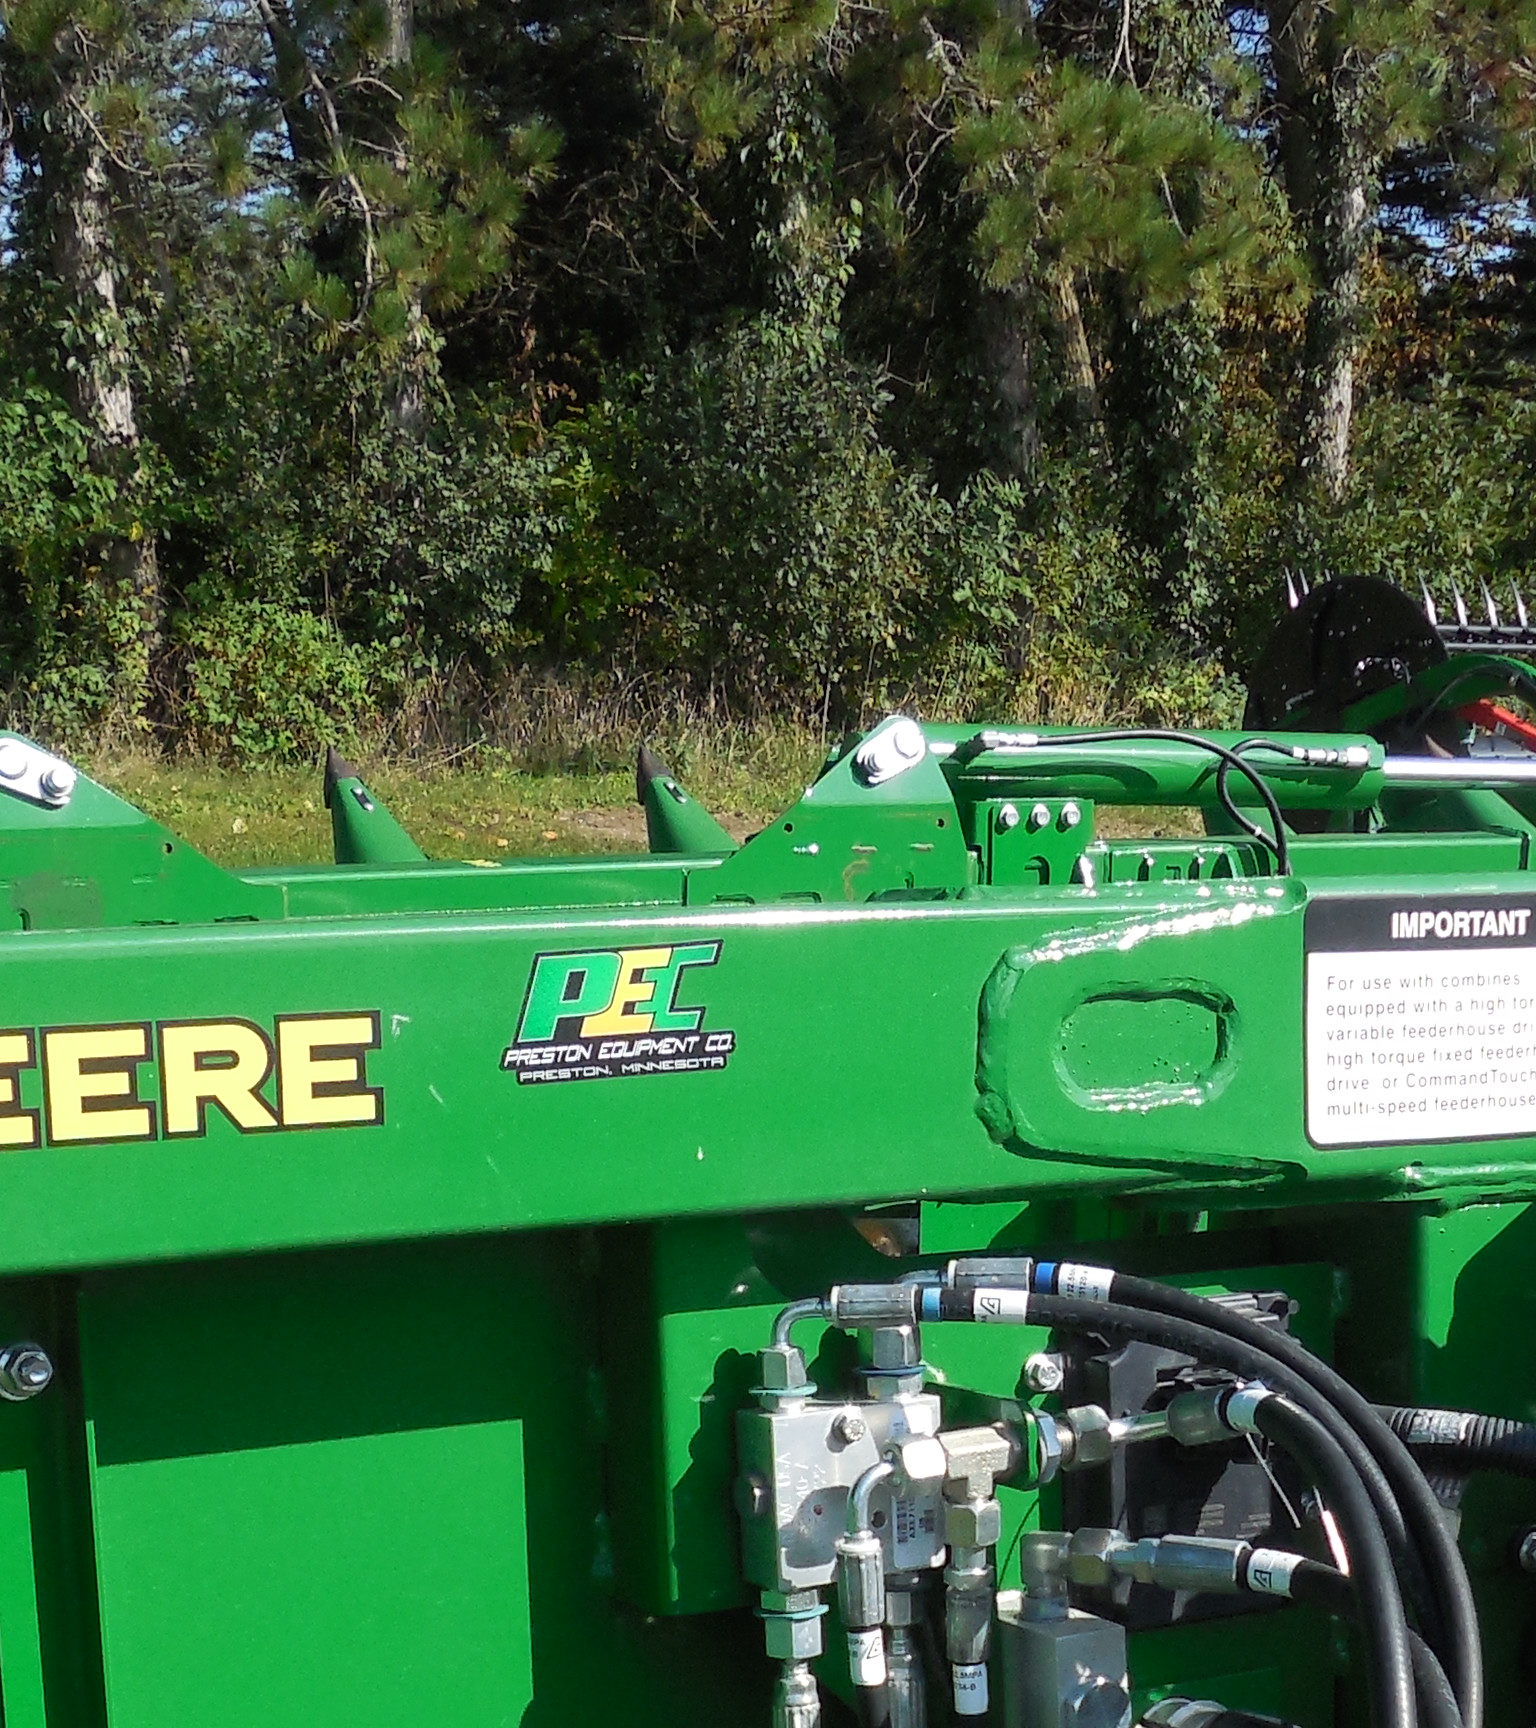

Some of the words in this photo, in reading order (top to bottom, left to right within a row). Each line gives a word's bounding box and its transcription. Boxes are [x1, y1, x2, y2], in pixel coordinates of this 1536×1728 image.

[1391, 909, 1531, 939] IMPORTANT
[1327, 976, 1354, 990] For
[1363, 977, 1391, 989] use
[1400, 974, 1432, 988] with
[1441, 972, 1520, 988] combines
[517, 943, 719, 1043] PEC
[1326, 1001, 1405, 1019] equipped
[1414, 999, 1446, 1013] with
[1455, 1000, 1463, 1012] a
[1470, 998, 1505, 1015] high
[1327, 1025, 1394, 1041] variable
[1402, 1021, 1505, 1039] feederhouse
[504, 1043, 593, 1067] PRESTON
[598, 1035, 699, 1059] EQUIPMENT
[705, 1033, 733, 1052] CO.
[1327, 1051, 1363, 1070] high
[1371, 1050, 1425, 1067] torque
[1433, 1048, 1473, 1063] fixed
[621, 1056, 725, 1074] MINNESOTA
[1327, 1076, 1369, 1092] drive
[1382, 1077, 1399, 1089] or
[1327, 1099, 1427, 1117] multi-speed
[1435, 1093, 1536, 1111] feederhouse
